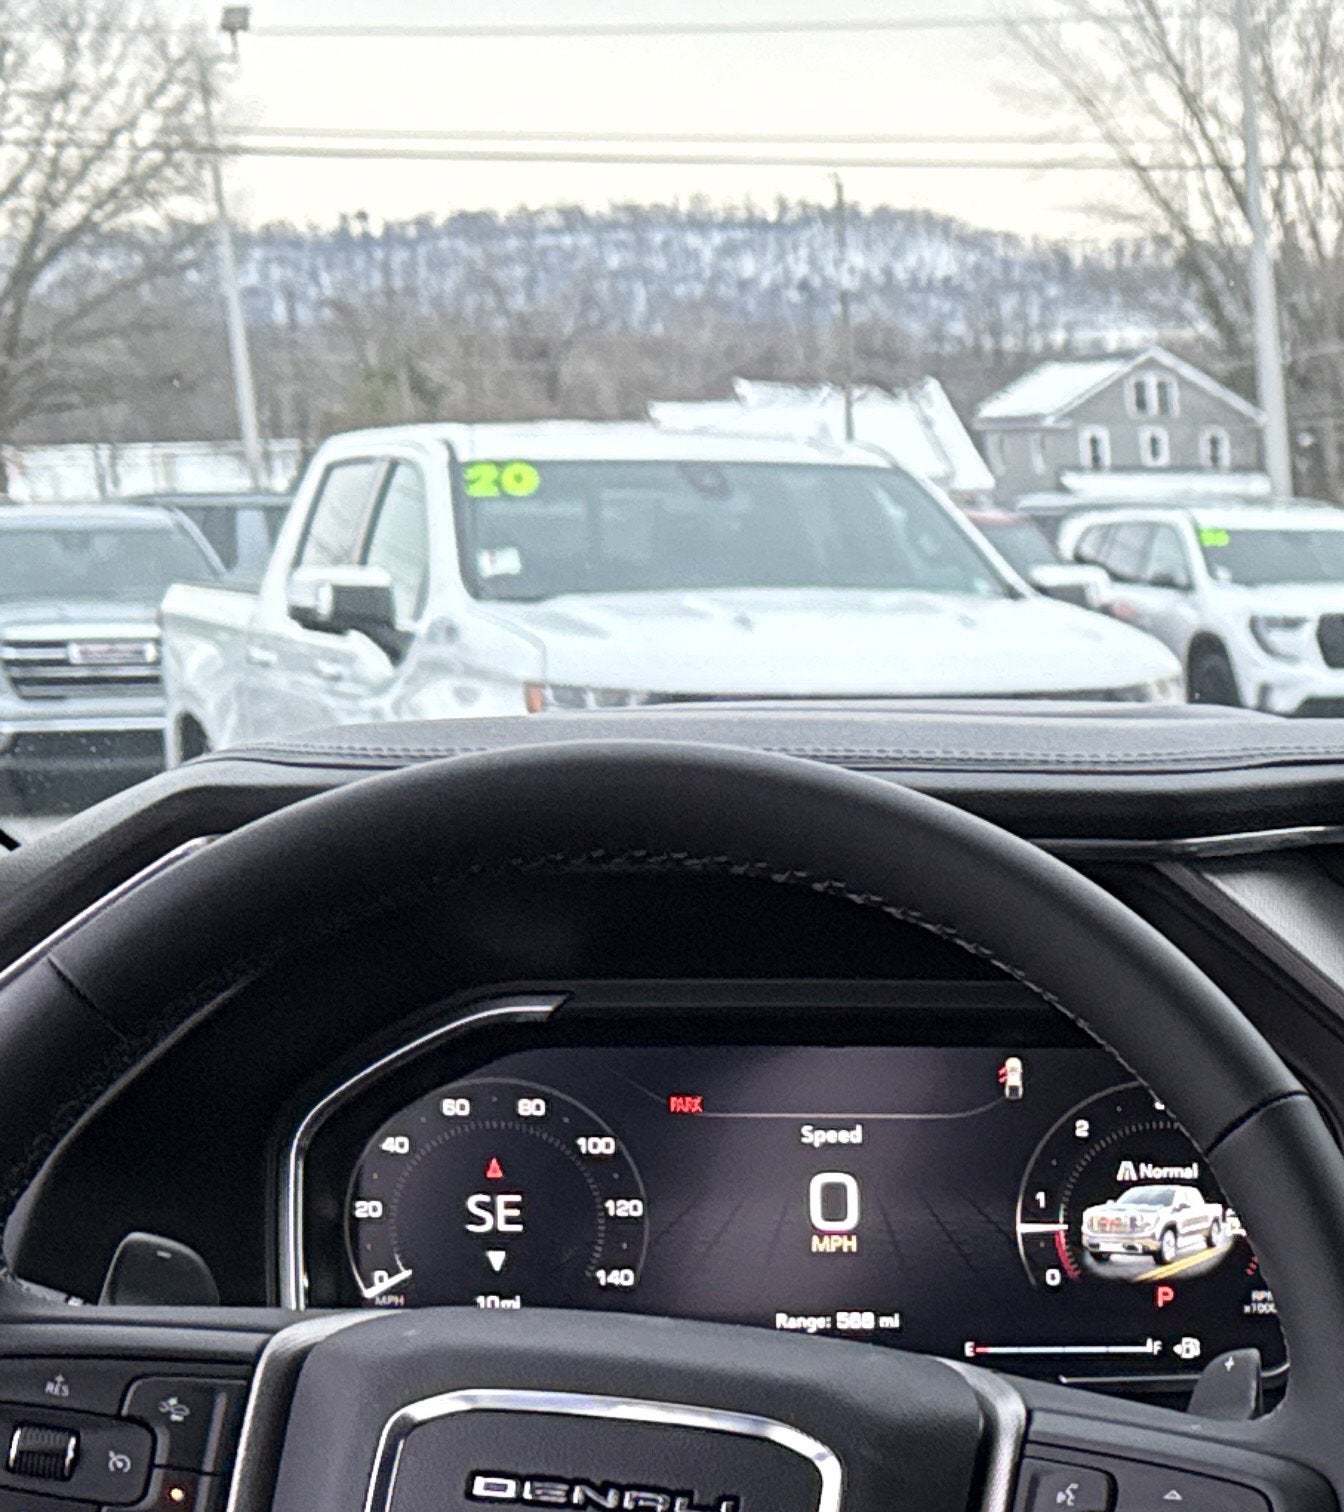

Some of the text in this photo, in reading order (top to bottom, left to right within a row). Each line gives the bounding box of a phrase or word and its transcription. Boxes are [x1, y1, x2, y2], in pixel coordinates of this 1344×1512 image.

[442, 1099, 470, 1116] 60
[518, 1099, 546, 1116] 80
[670, 1097, 703, 1113] PARK
[801, 1125, 862, 1148] Speed
[1075, 1119, 1090, 1137] 2
[380, 1136, 410, 1155] 40
[576, 1136, 616, 1155] 100
[1139, 1162, 1198, 1179] Normal
[604, 1200, 643, 1217] 120
[809, 1172, 860, 1232] 0
[1036, 1191, 1046, 1208] 1
[354, 1200, 383, 1218] 20
[465, 1194, 524, 1232] SE
[811, 1235, 857, 1253] MPH
[596, 1269, 634, 1286] 140
[1045, 1268, 1062, 1286] 0
[1157, 1285, 1174, 1308] P
[776, 1313, 831, 1333] Range:
[879, 1313, 900, 1328] mi
[45, 1380, 69, 1397] RES
